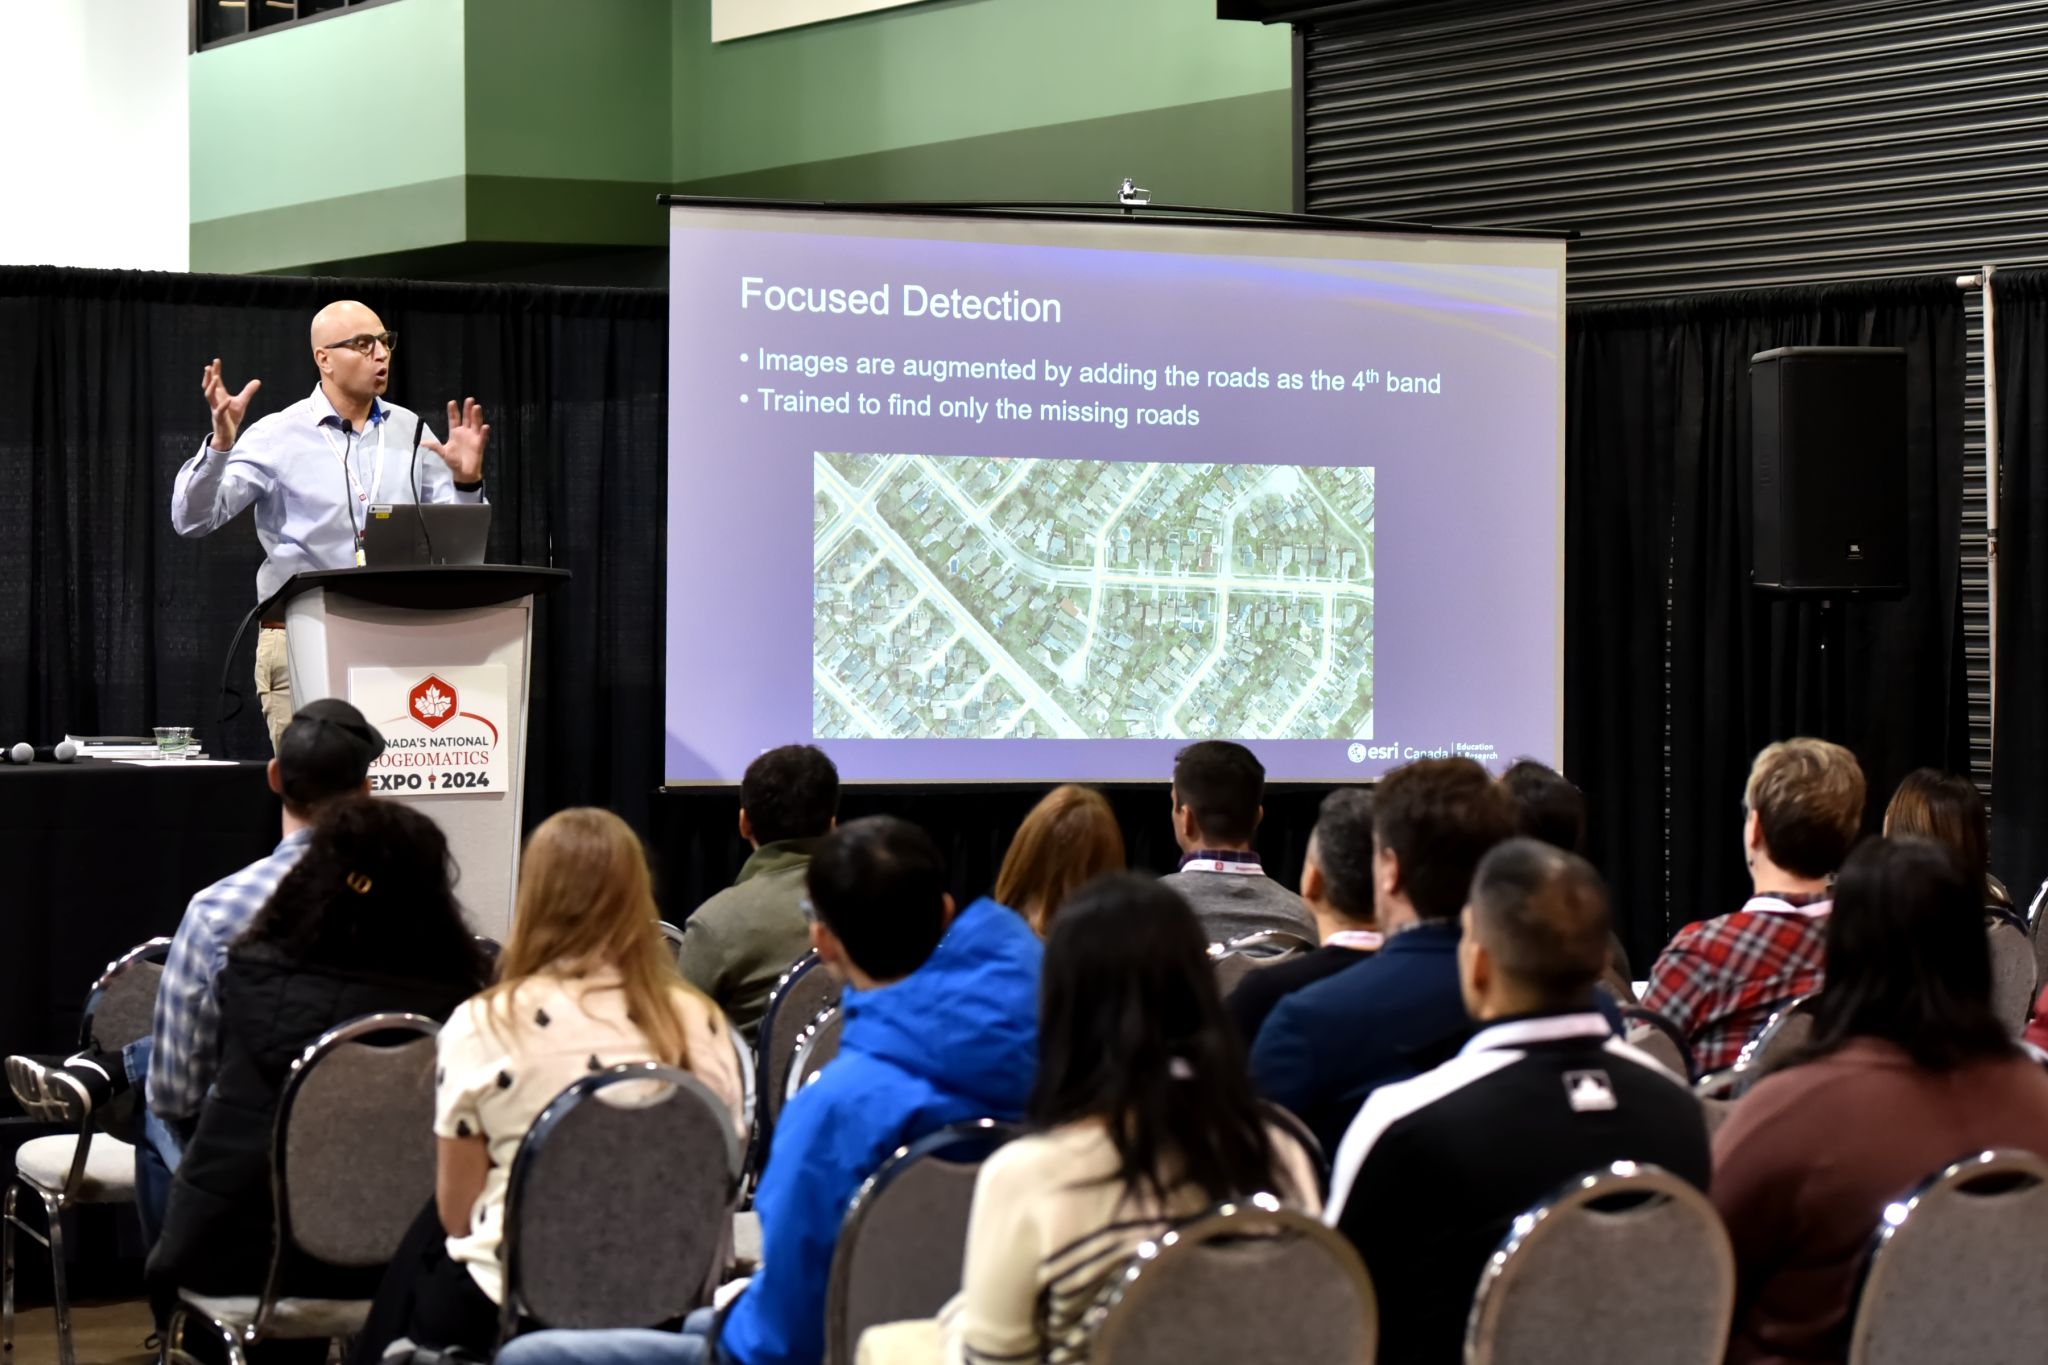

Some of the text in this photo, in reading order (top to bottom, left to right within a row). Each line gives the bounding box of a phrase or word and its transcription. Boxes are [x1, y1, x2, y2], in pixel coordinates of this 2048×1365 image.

[741, 276, 1061, 323] Focused Detection
[759, 347, 1441, 394] Images are augmented by adding the roads as the 4th band
[757, 388, 1200, 429] Trained to find only the missing roads
[429, 736, 489, 747] NATIONAL
[1456, 742, 1494, 751] Education
[1367, 742, 1449, 760] esri Canada
[368, 772, 490, 790] EXPO 2024
